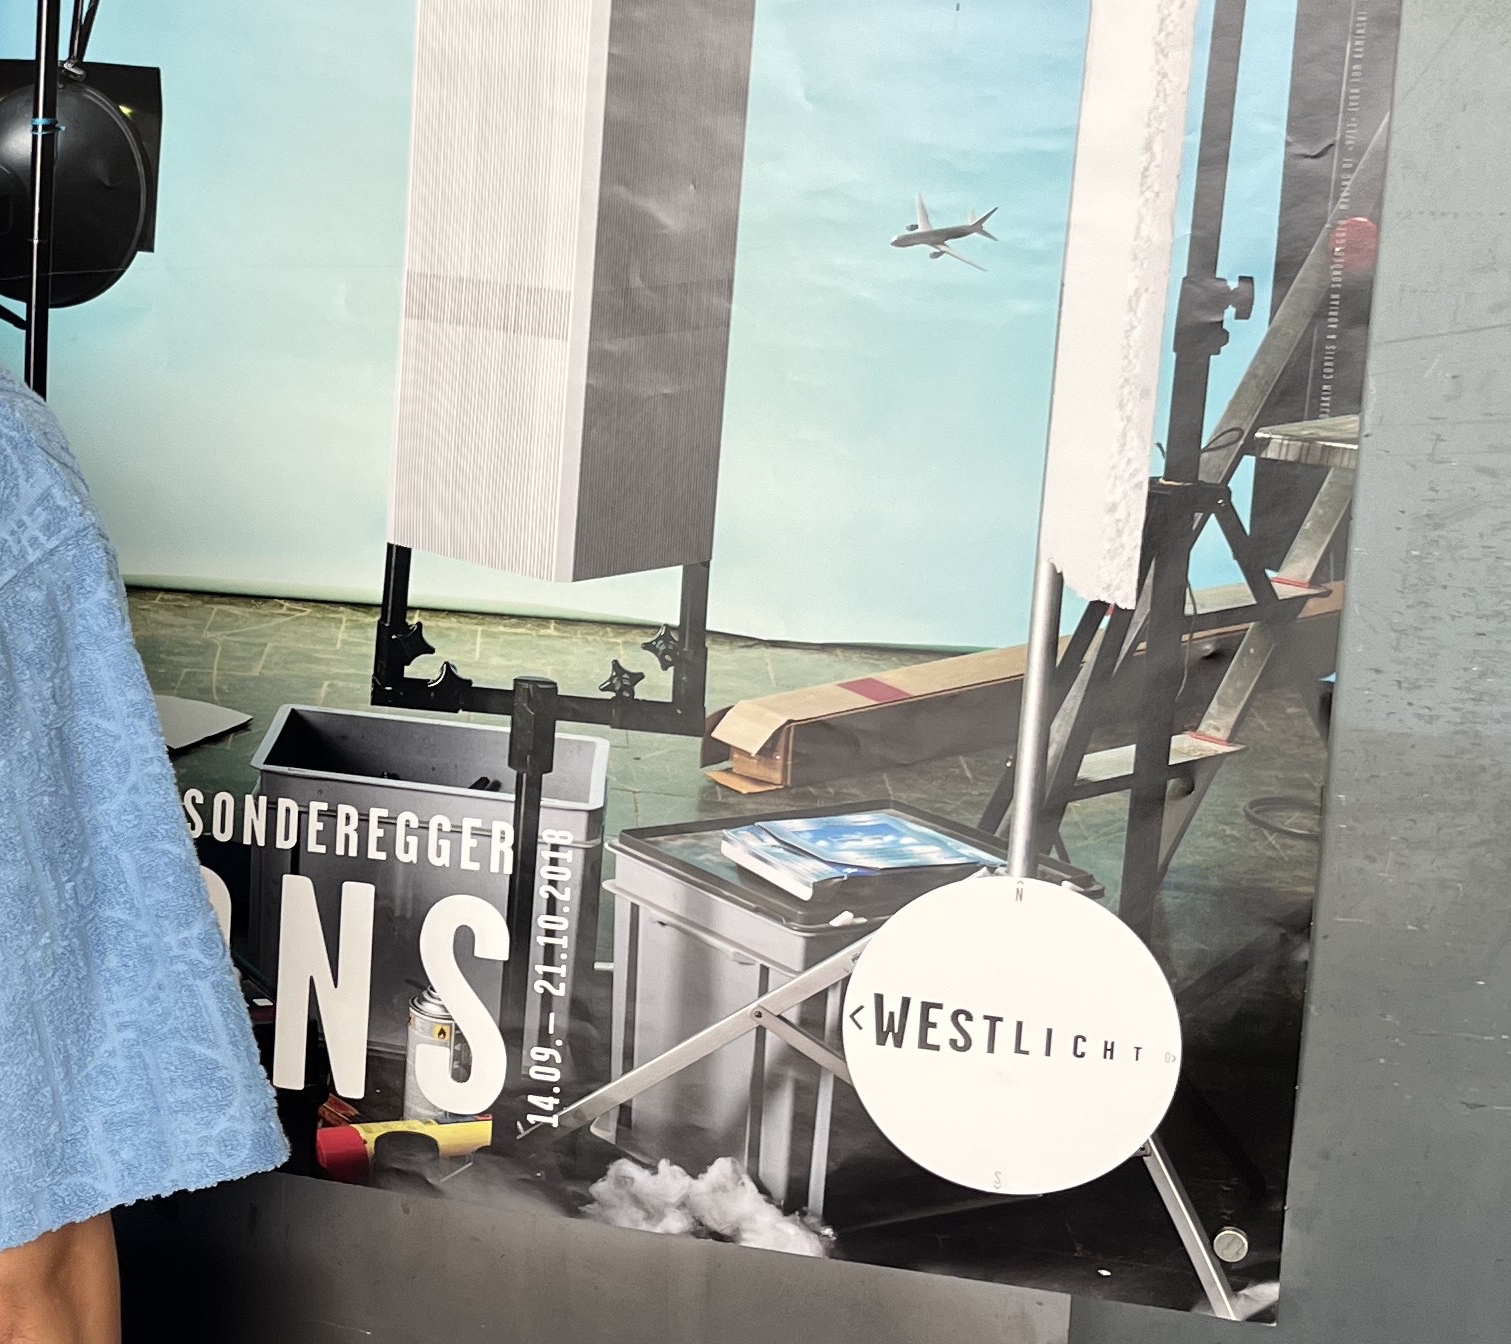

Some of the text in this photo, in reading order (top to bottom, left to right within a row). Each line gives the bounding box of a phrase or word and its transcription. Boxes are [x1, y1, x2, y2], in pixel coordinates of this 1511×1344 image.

[184, 787, 514, 875] SONDEREGGER
[534, 828, 574, 997] 21.10.2018
[874, 993, 1143, 1062] WESTLICHT
